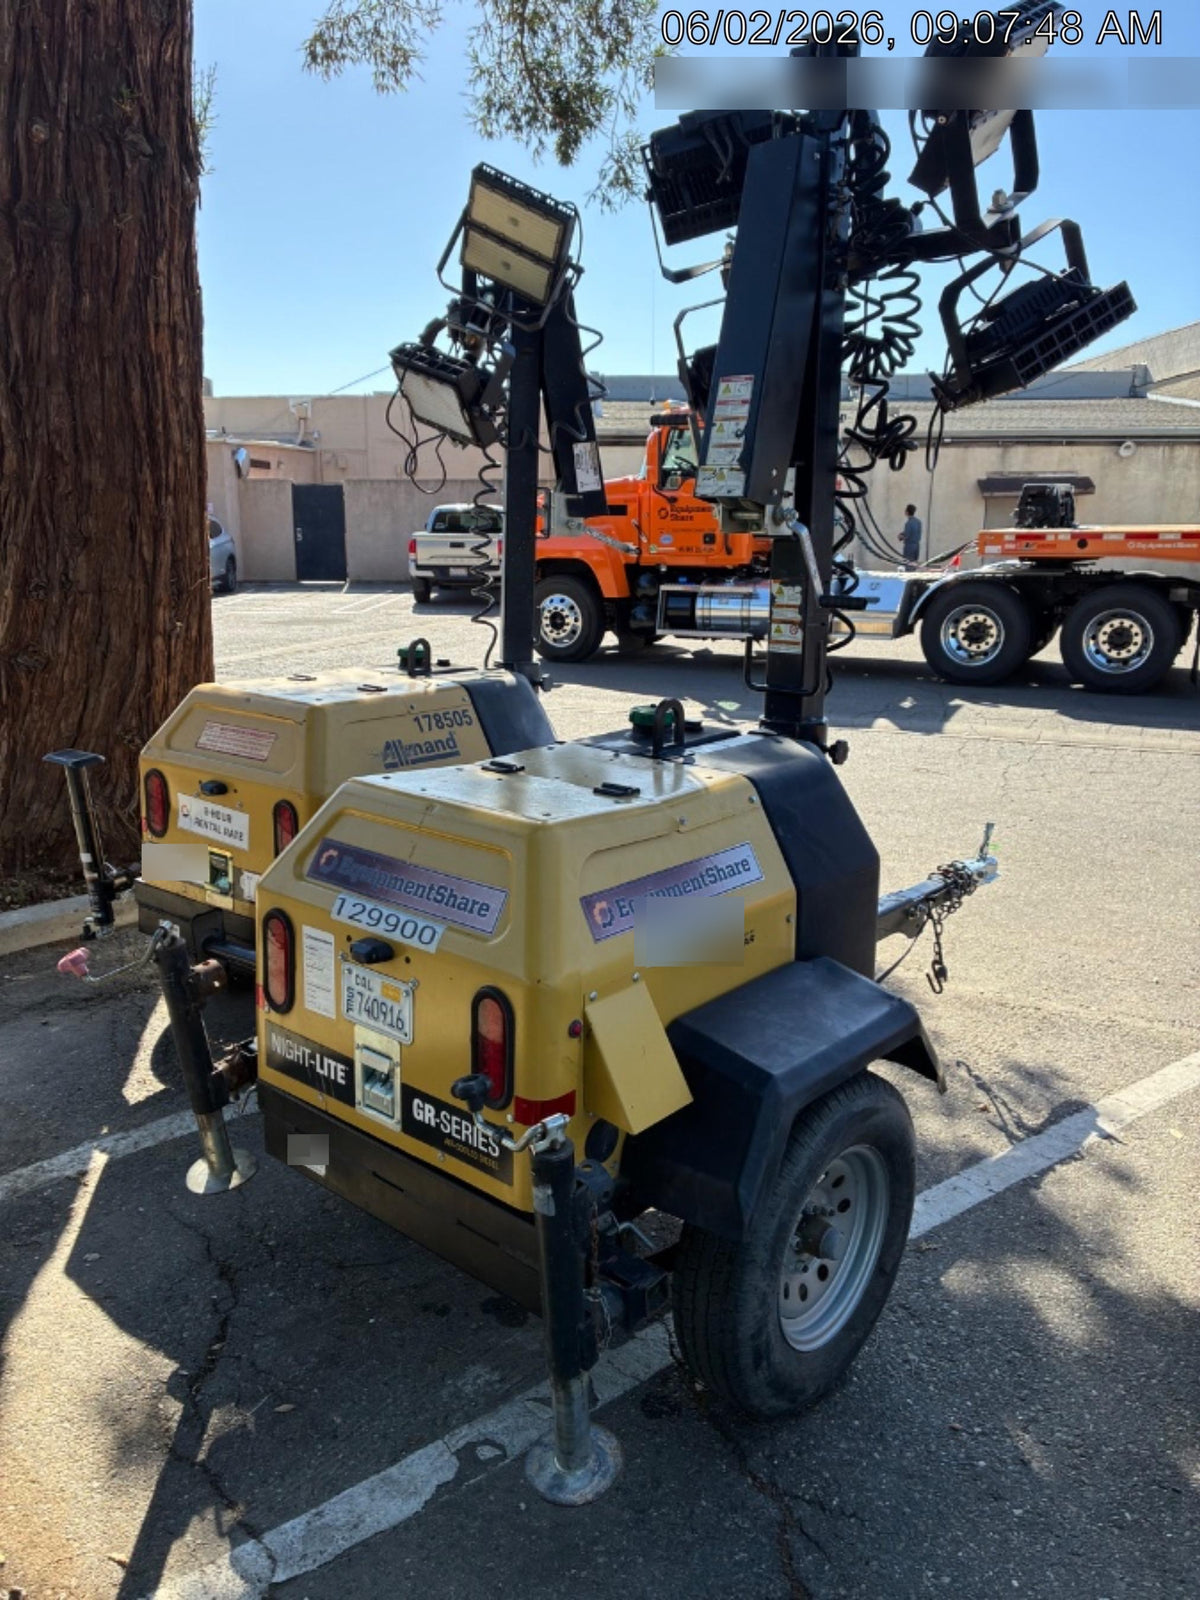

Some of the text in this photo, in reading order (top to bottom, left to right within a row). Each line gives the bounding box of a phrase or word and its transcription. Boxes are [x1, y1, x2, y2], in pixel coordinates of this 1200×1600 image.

[413, 709, 473, 733] 178505
[334, 897, 438, 946] 129900
[357, 991, 405, 1031] 740916
[271, 1032, 346, 1086] NIGHT-LITE
[412, 1098, 500, 1157] GR-SERIES
